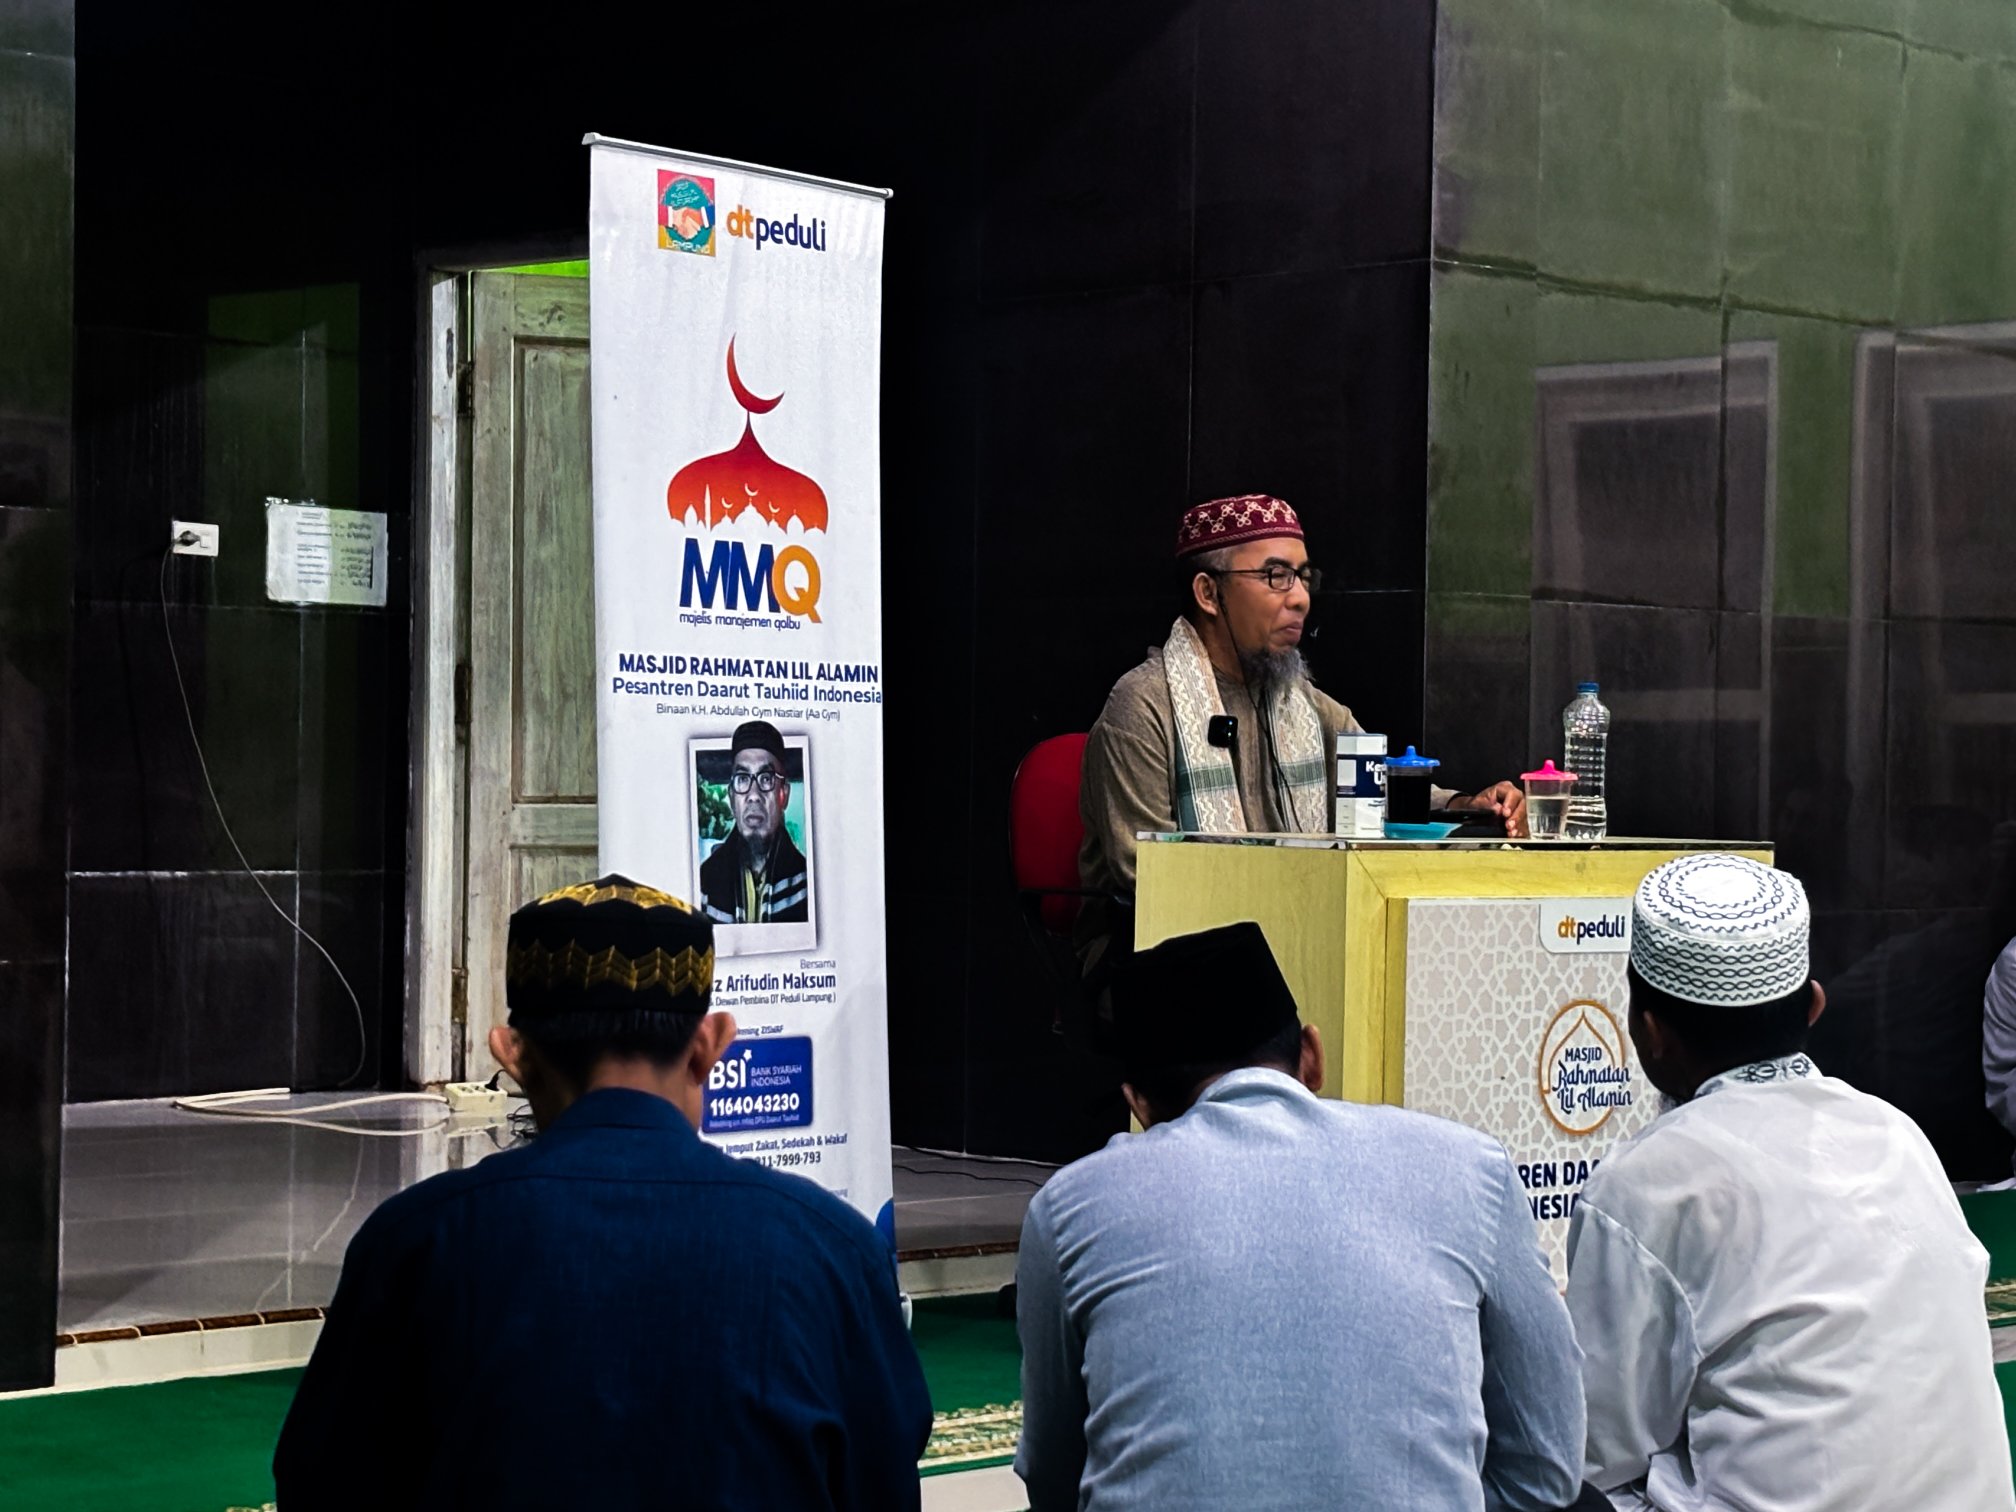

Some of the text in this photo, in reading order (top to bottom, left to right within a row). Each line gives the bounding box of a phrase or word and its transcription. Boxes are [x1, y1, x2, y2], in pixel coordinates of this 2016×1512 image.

[726, 204, 827, 251] dtpeduli
[679, 537, 822, 623] MMQ
[679, 610, 712, 627] majelis
[715, 612, 771, 630] manajemen
[619, 653, 878, 683] MASJID RAHMATAN LIL ALAMIN
[612, 677, 881, 703] Pesantren Daarut Tauhiid Indonesia
[656, 703, 690, 714] Binaan
[710, 704, 749, 717] Abdullah
[806, 708, 820, 720] (Aa
[1557, 914, 1625, 945] dtpeduli
[800, 958, 837, 969] Bersama
[726, 973, 779, 992] Arifudin
[782, 972, 836, 990] Maksum
[1565, 1047, 1602, 1064] MASJID
[709, 1058, 747, 1090] BSI
[751, 1066, 772, 1077] BANK
[751, 1075, 791, 1087] INDONESIA
[1552, 1060, 1632, 1092] Rahmatan
[710, 1093, 800, 1117] 1164043230
[1577, 1085, 1633, 1112] Alamin
[781, 1136, 815, 1149] Sedekah
[816, 1135, 823, 1146] &
[824, 1133, 848, 1145] Wakaf
